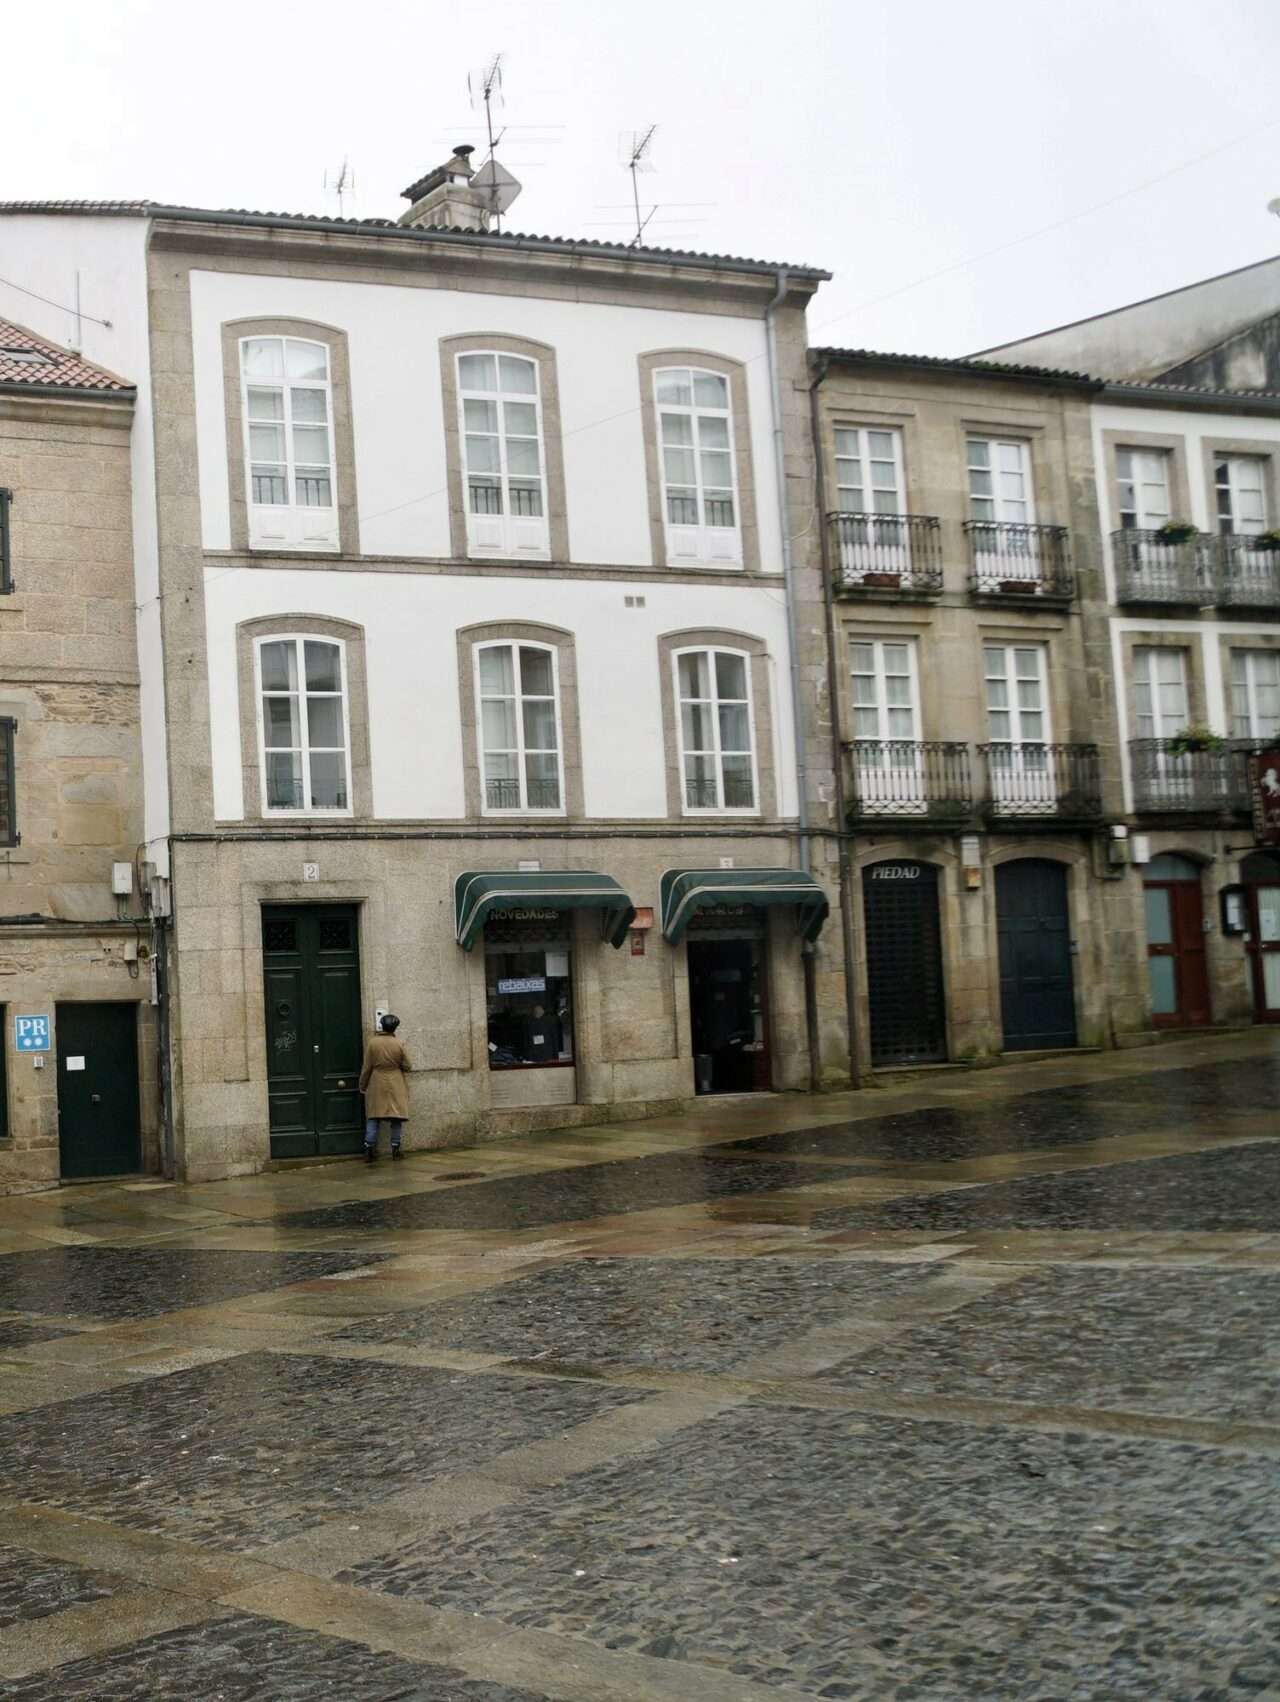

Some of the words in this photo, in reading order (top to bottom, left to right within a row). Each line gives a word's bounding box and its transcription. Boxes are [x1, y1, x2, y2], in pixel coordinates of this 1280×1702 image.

[307, 865, 316, 880] 2
[872, 866, 920, 879] PIEDAD
[490, 910, 560, 920] NOVEDADES
[19, 1019, 48, 1036] PR
